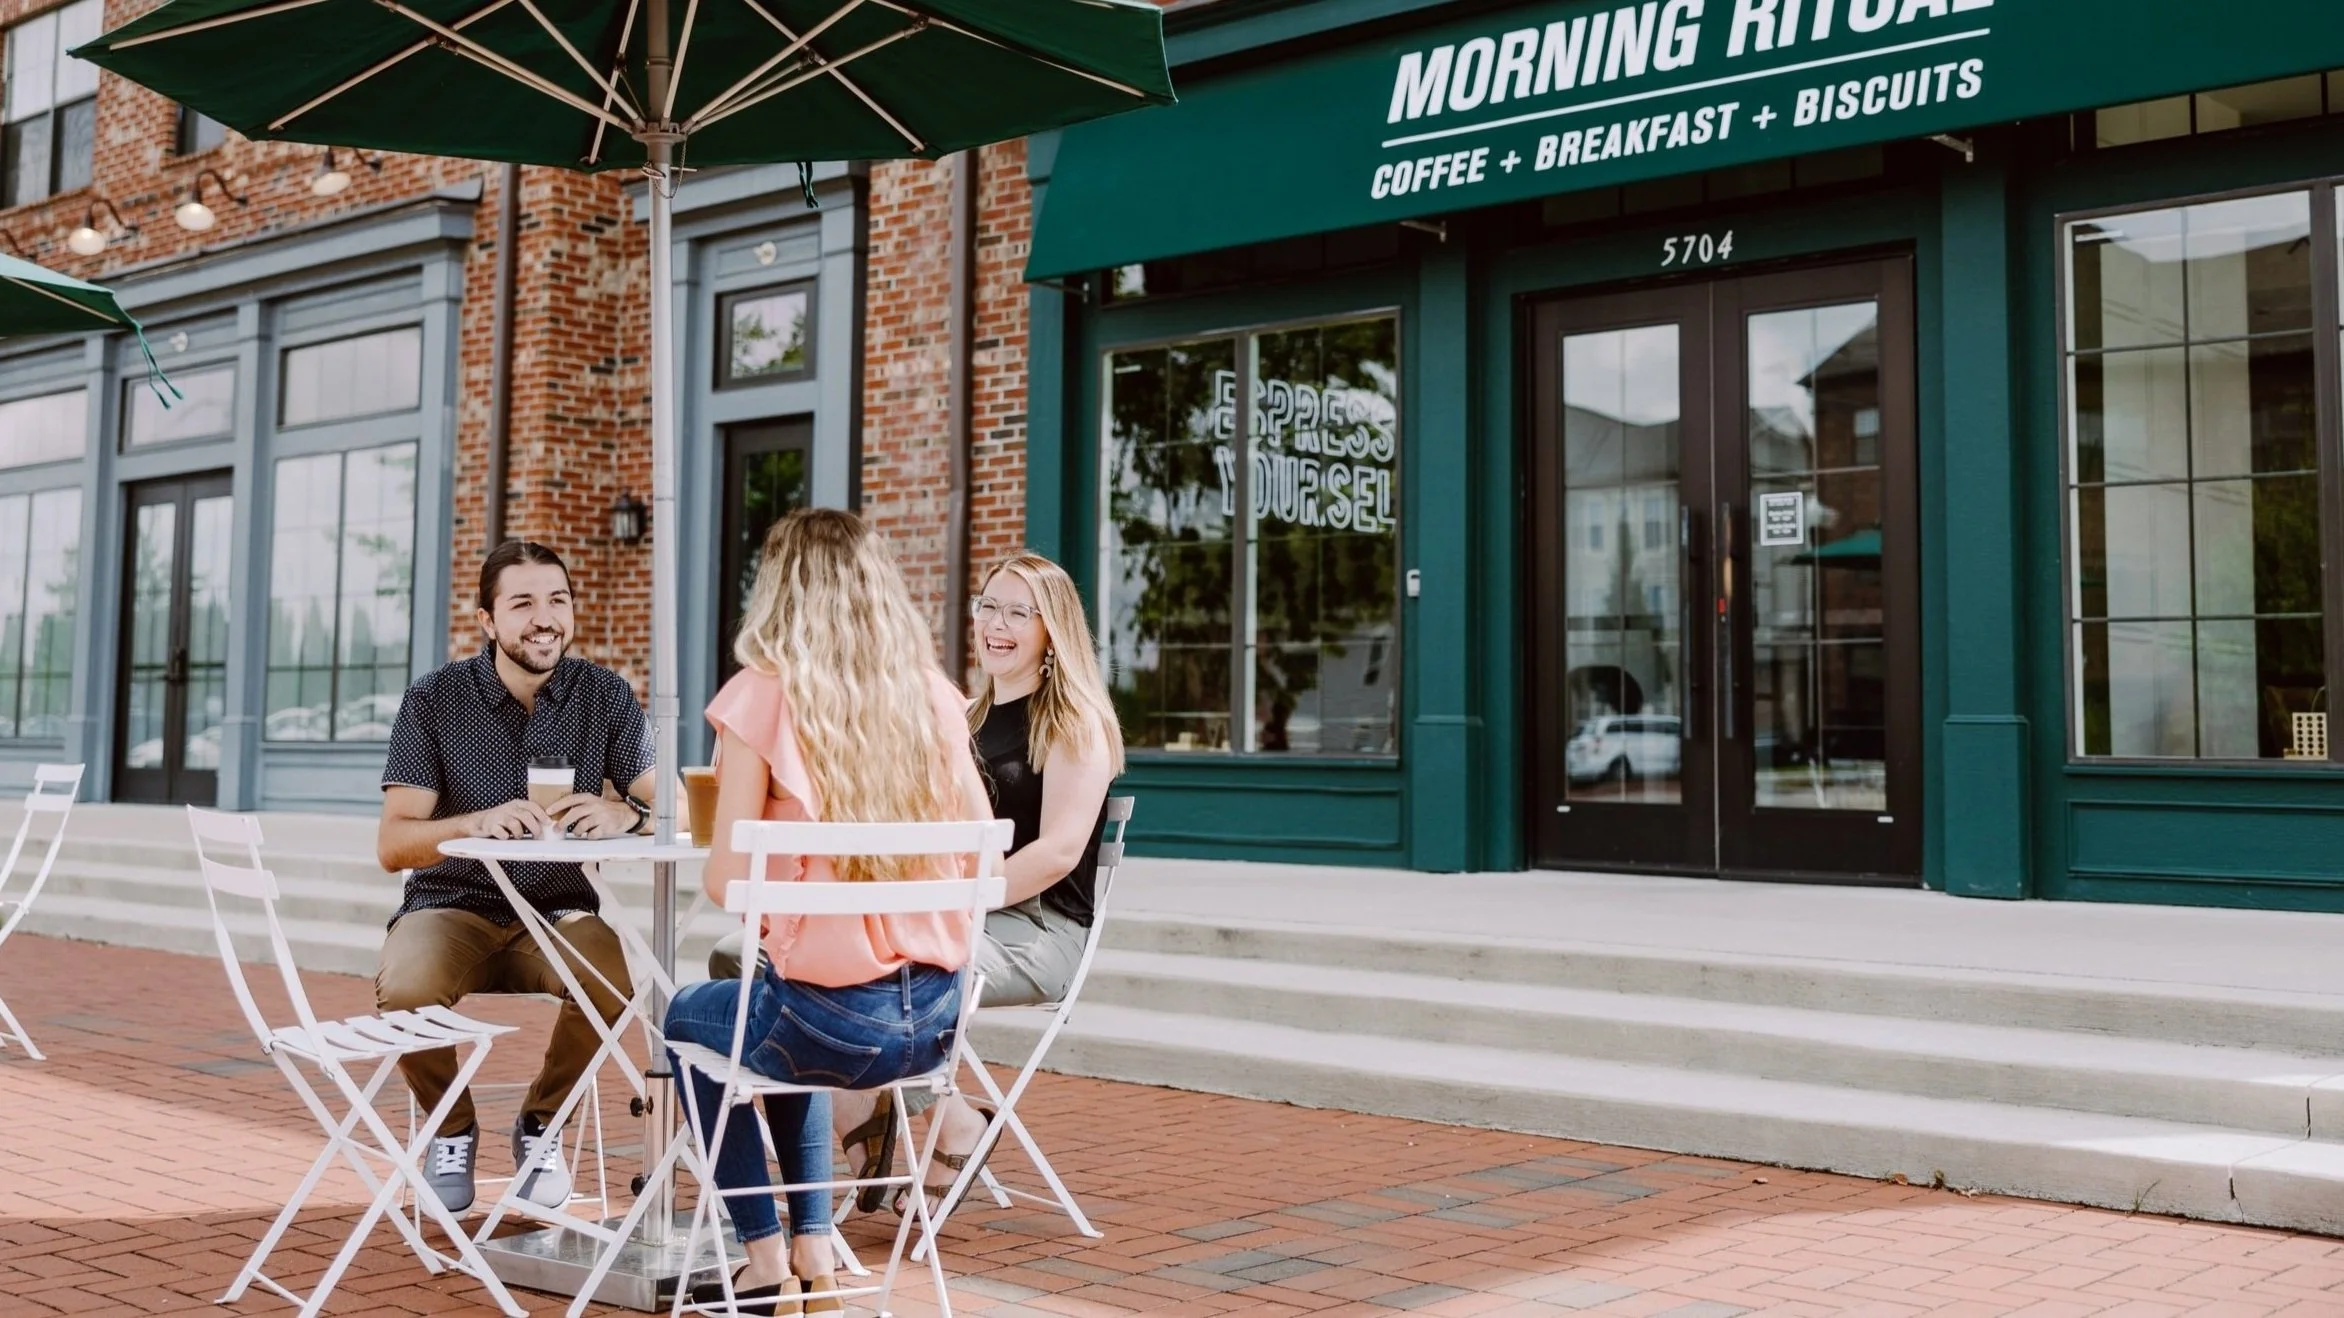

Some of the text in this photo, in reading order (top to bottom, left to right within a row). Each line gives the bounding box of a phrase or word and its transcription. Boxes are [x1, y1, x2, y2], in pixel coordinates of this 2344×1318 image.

[1387, 0, 1994, 124] MORNING RIT
[1371, 147, 1490, 199] COFFEE
[1534, 102, 1740, 171] BREAKFAST
[1793, 58, 1984, 127] BISCUITS
[1661, 230, 1733, 267] 5704
